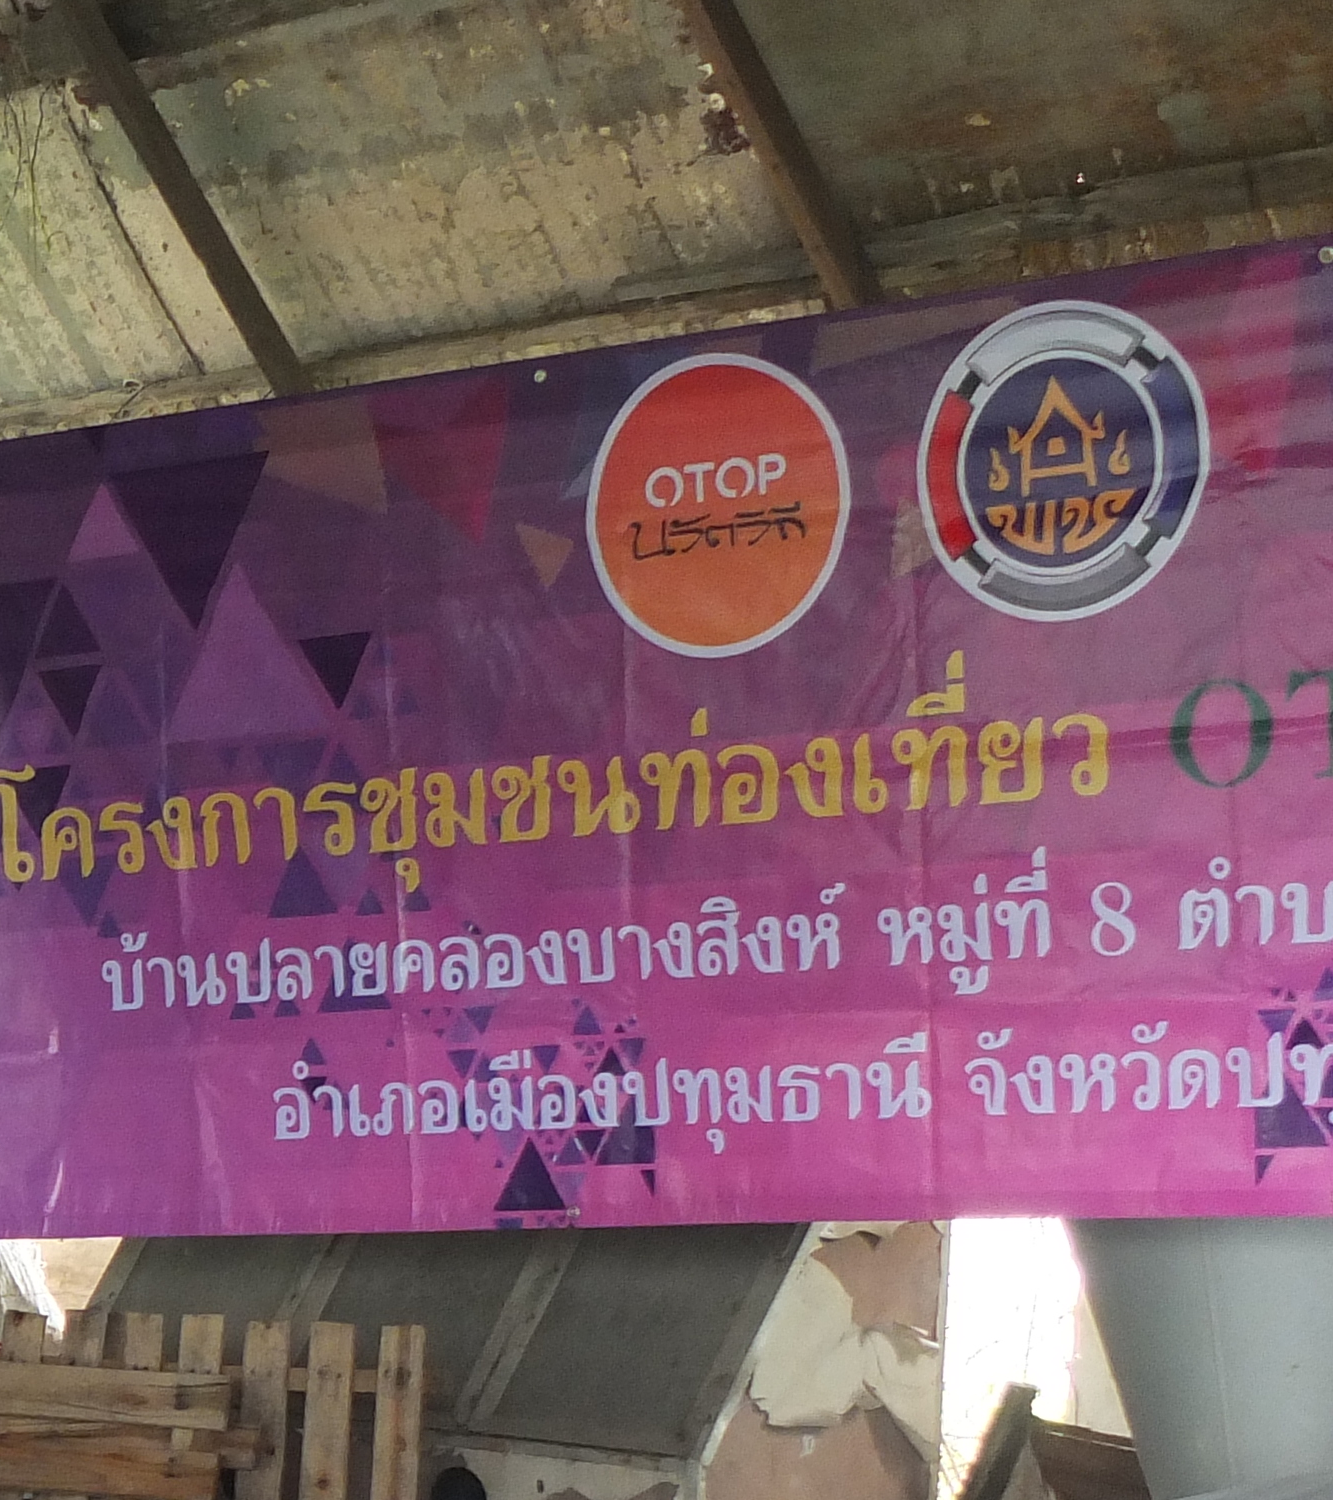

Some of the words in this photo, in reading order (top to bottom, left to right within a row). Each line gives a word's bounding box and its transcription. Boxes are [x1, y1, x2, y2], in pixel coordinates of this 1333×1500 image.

[645, 452, 787, 508] OTOP
[102, 883, 846, 1012] บ้านปลายคลองบางสิงห์
[877, 846, 1051, 995] หมู่ที่
[1091, 882, 1135, 956] 8
[273, 1031, 931, 1154] อำเภอเมืองปทุมธานี
